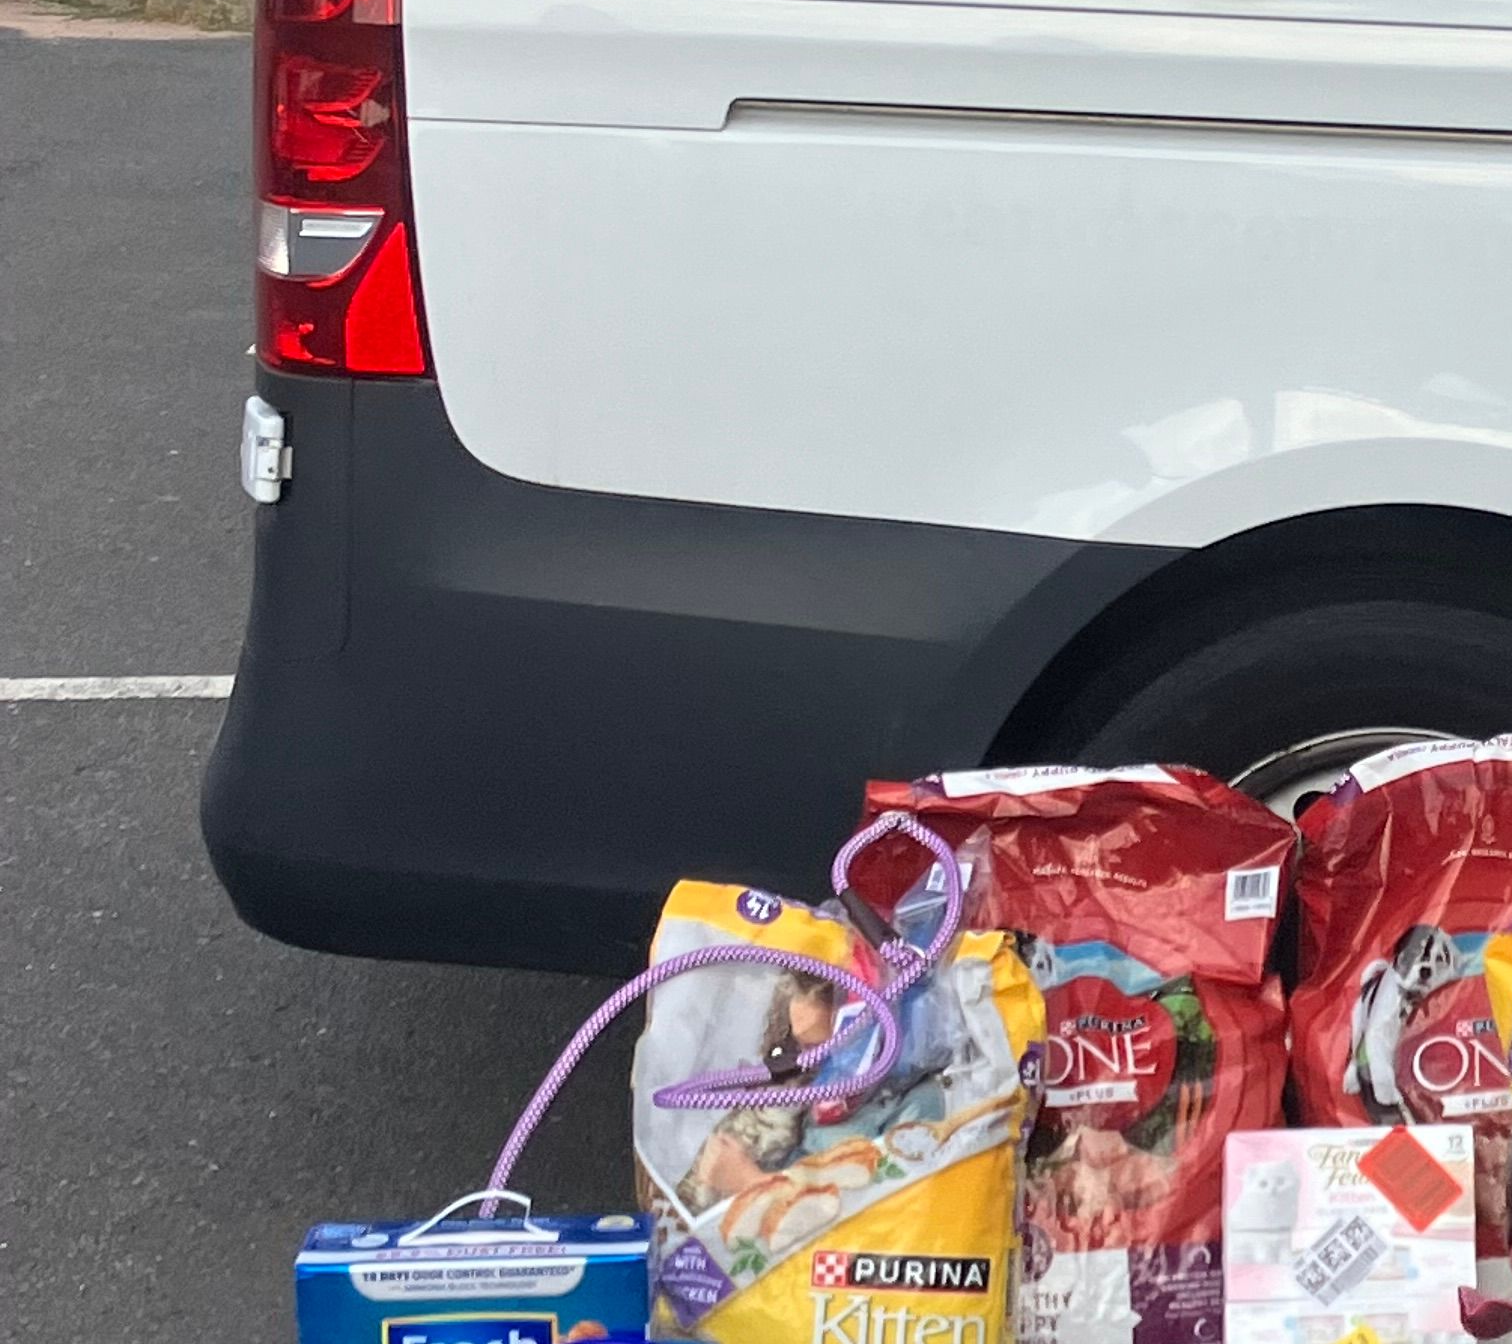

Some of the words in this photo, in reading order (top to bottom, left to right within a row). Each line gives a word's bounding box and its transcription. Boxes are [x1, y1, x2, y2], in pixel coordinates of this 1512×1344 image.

[1077, 1014, 1145, 1035] PURINA
[1046, 1026, 1158, 1086] ONE
[1413, 1035, 1512, 1092] ON
[1308, 1143, 1362, 1169] Fan
[854, 1258, 984, 1288] PURINA
